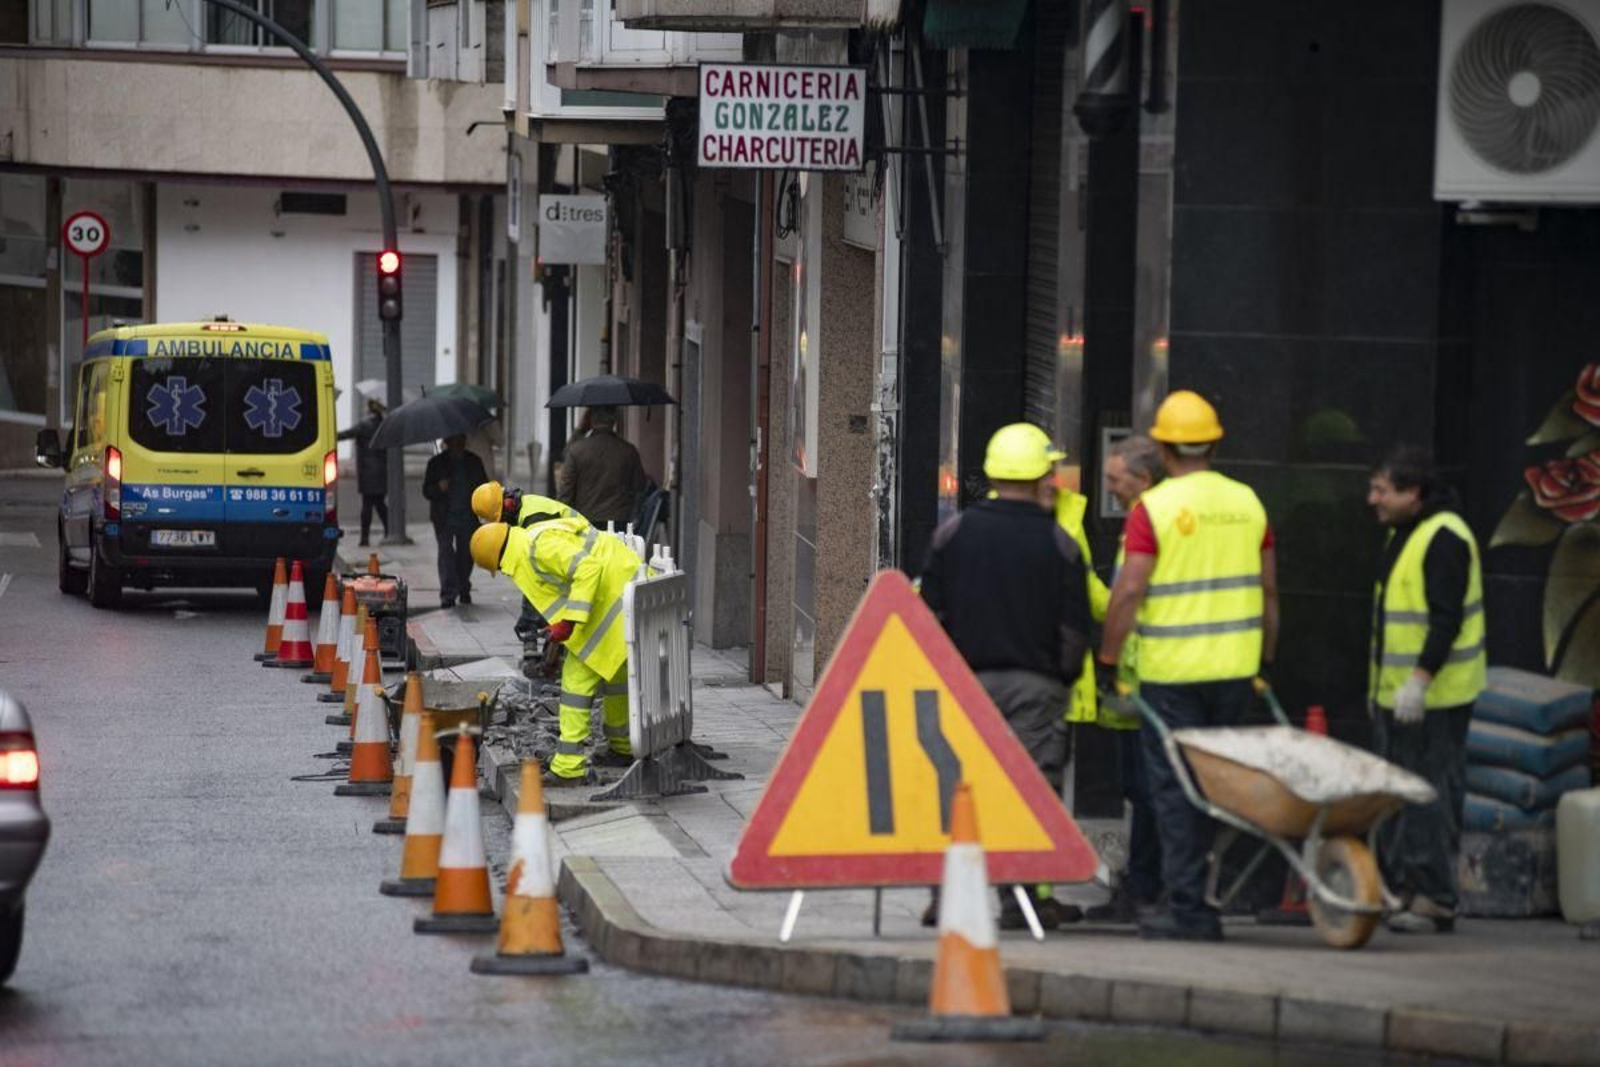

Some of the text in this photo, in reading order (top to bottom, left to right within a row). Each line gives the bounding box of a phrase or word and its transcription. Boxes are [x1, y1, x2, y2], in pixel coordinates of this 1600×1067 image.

[705, 69, 860, 100] CARNICERIA
[715, 101, 850, 133] GONZALEZ
[703, 134, 861, 167] CHARCUTERIA
[72, 226, 100, 242] 30
[154, 339, 294, 359] AMBULANCIA
[245, 488, 268, 501] 988
[271, 489, 286, 502] 36
[289, 489, 303, 502] 61
